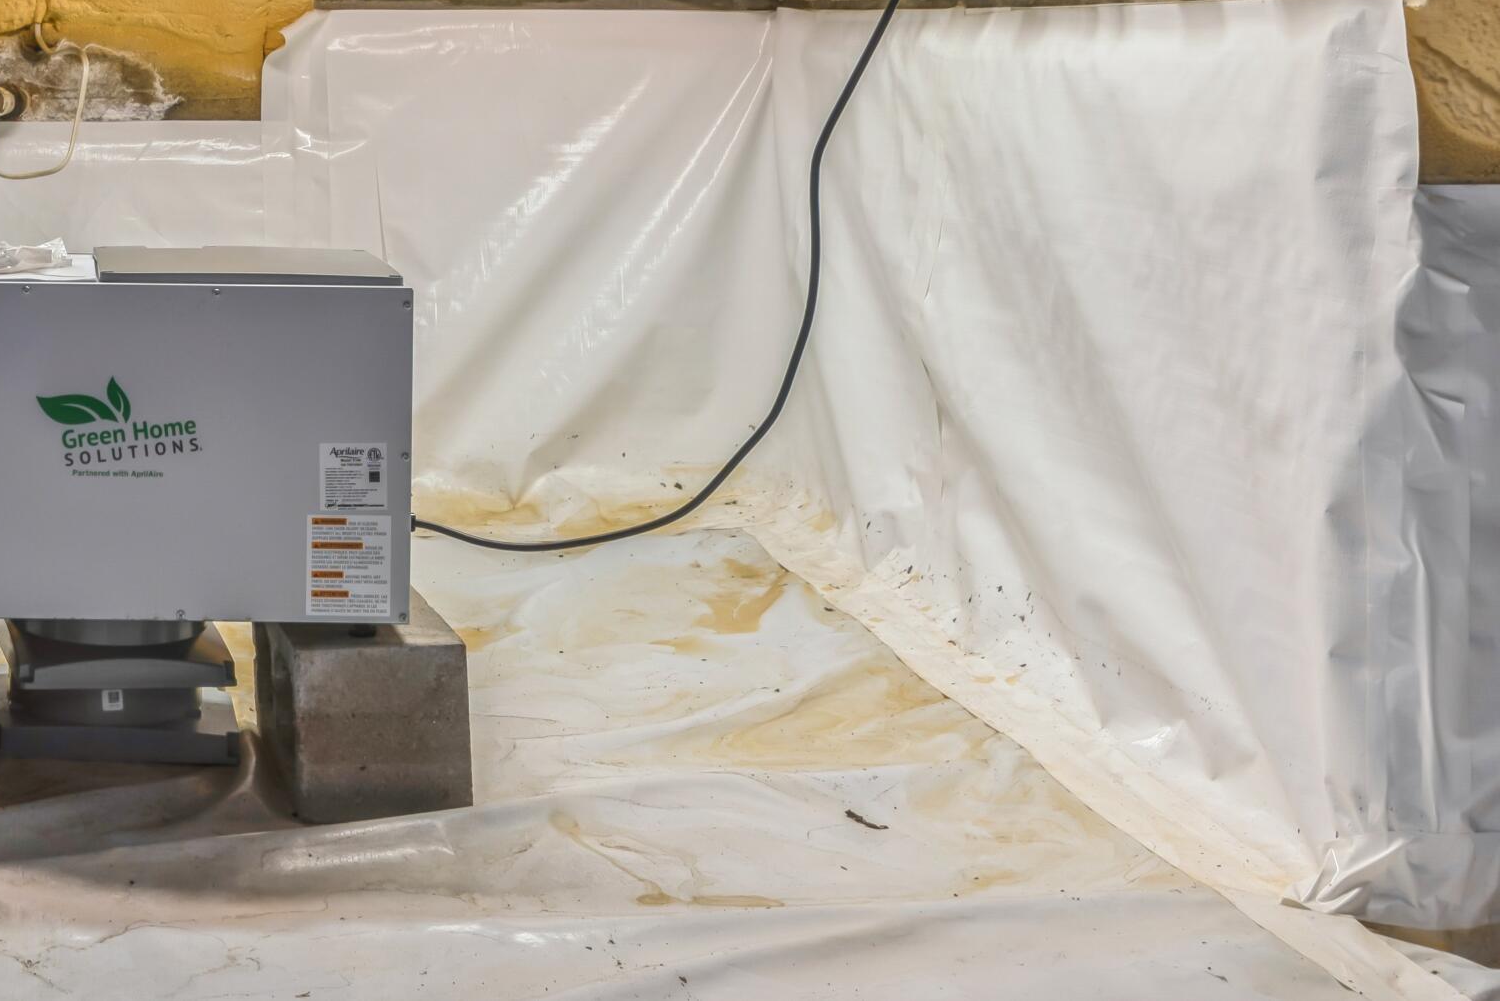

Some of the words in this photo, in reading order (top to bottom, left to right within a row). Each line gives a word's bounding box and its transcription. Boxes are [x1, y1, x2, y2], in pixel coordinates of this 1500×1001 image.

[62, 428, 126, 449] Green
[132, 420, 197, 442] Home
[64, 437, 199, 467] SOLUTIONS
[329, 447, 365, 458] Aprilaire
[72, 469, 110, 478] Partnered
[112, 469, 129, 478] with
